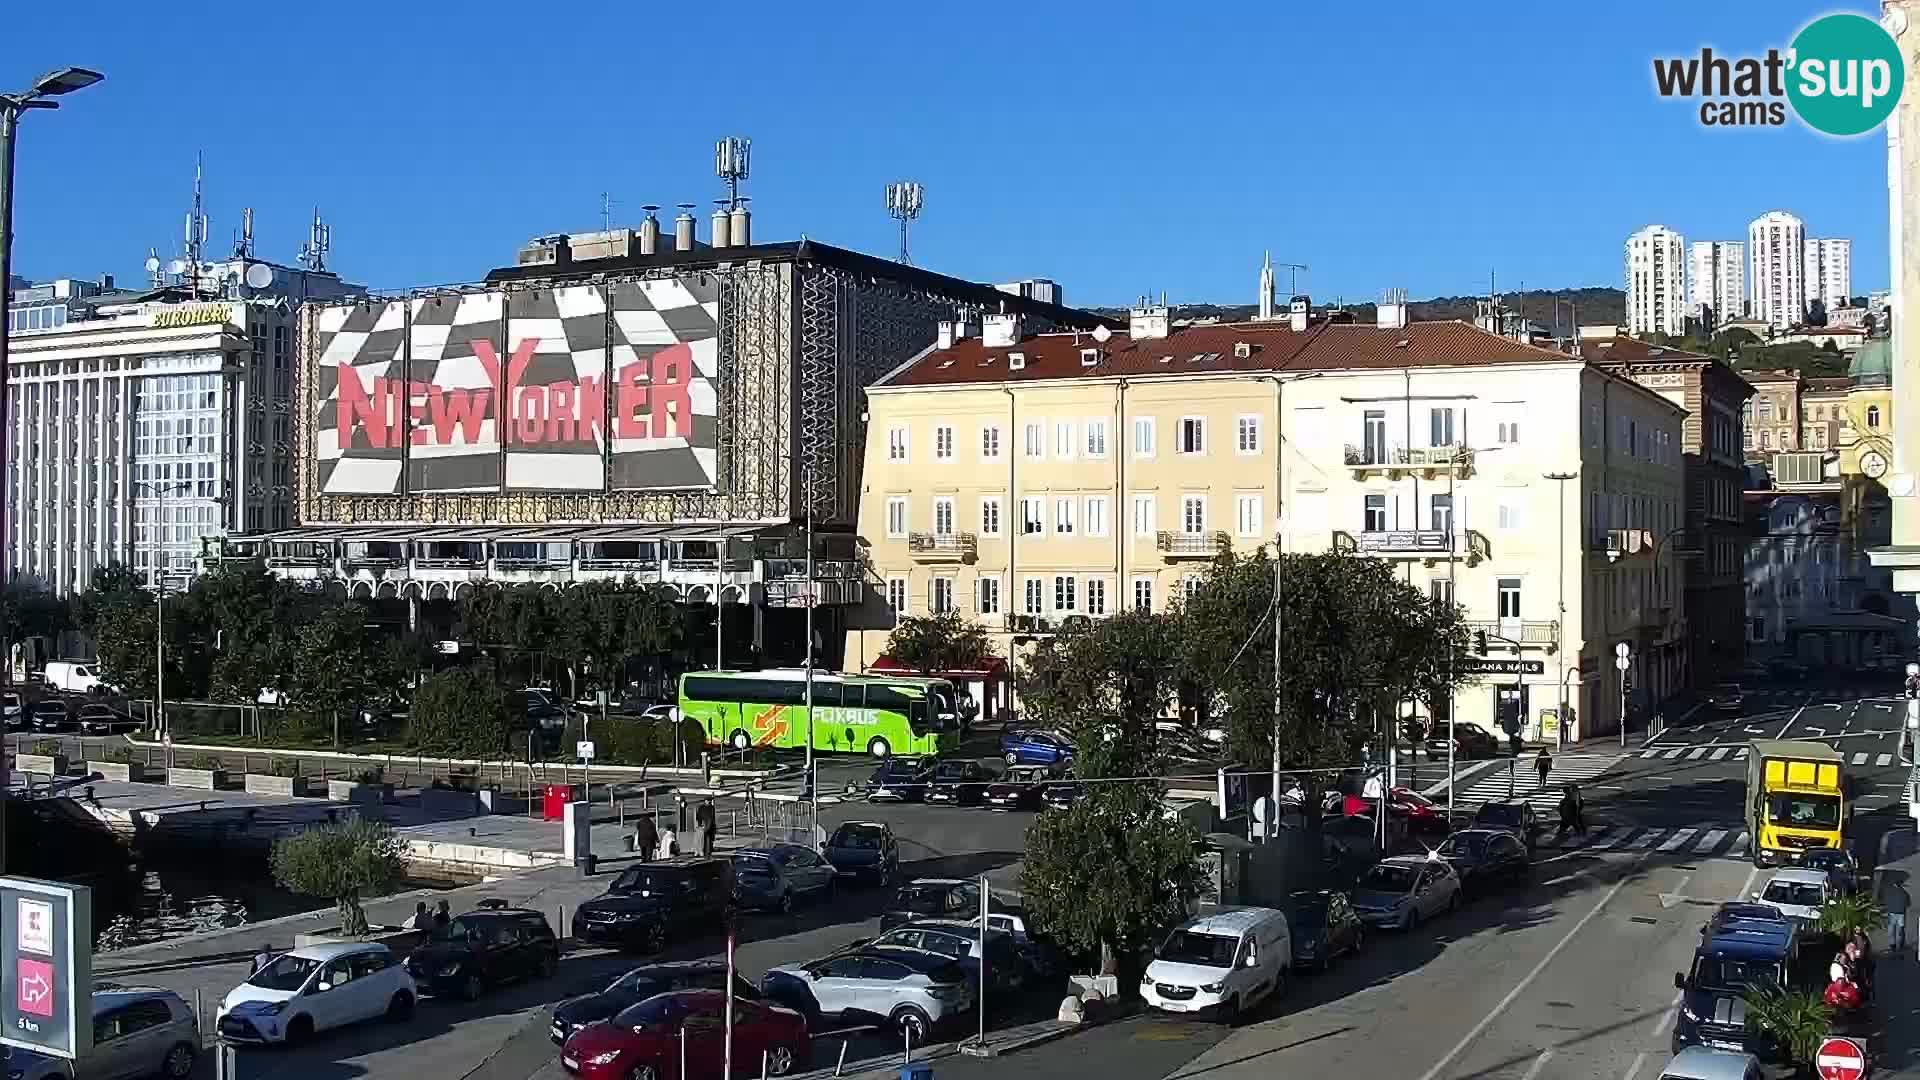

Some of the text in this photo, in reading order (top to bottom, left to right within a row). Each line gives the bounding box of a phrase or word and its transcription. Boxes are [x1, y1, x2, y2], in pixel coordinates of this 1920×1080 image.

[1507, 663, 1539, 672] NAILS
[18, 1017, 39, 1032] 5 km
